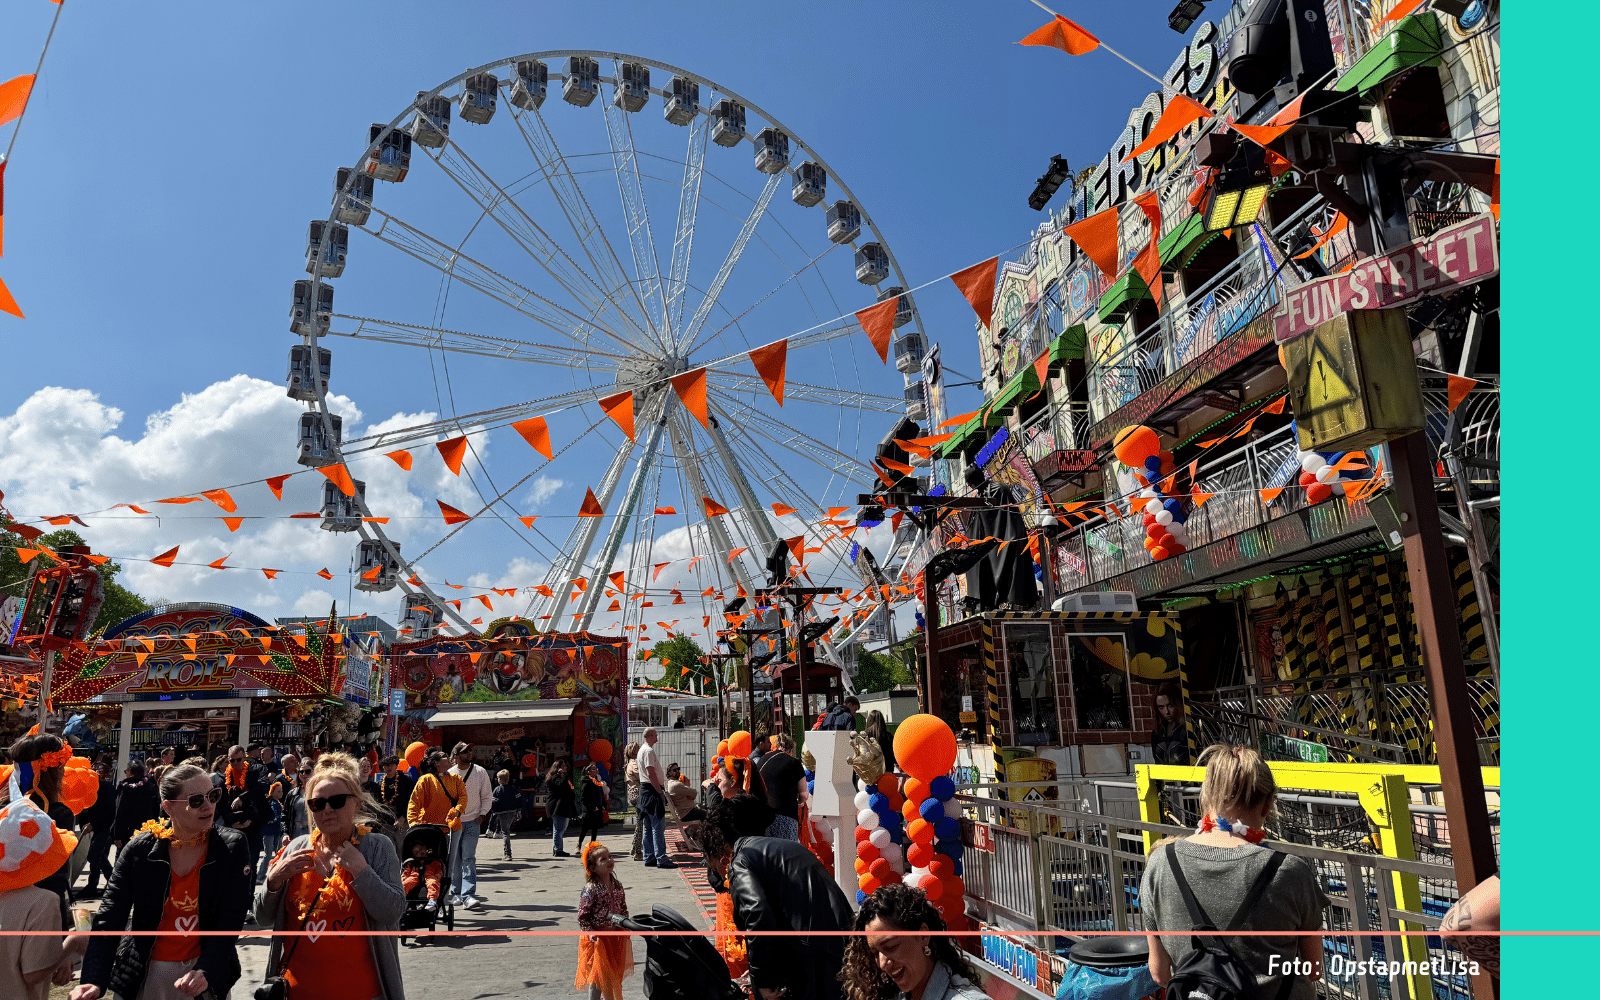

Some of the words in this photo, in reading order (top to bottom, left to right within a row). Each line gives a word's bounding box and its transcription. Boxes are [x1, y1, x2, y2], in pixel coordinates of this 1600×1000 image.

[1286, 278, 1343, 332] FUN
[1349, 224, 1483, 310] STREET
[116, 614, 239, 662] ROCK
[142, 647, 236, 690] ROLL
[1265, 734, 1283, 753] THE
[1284, 738, 1312, 761] JOKER
[1312, 752, 1320, 763] ST
[981, 927, 1015, 976] FAMILY
